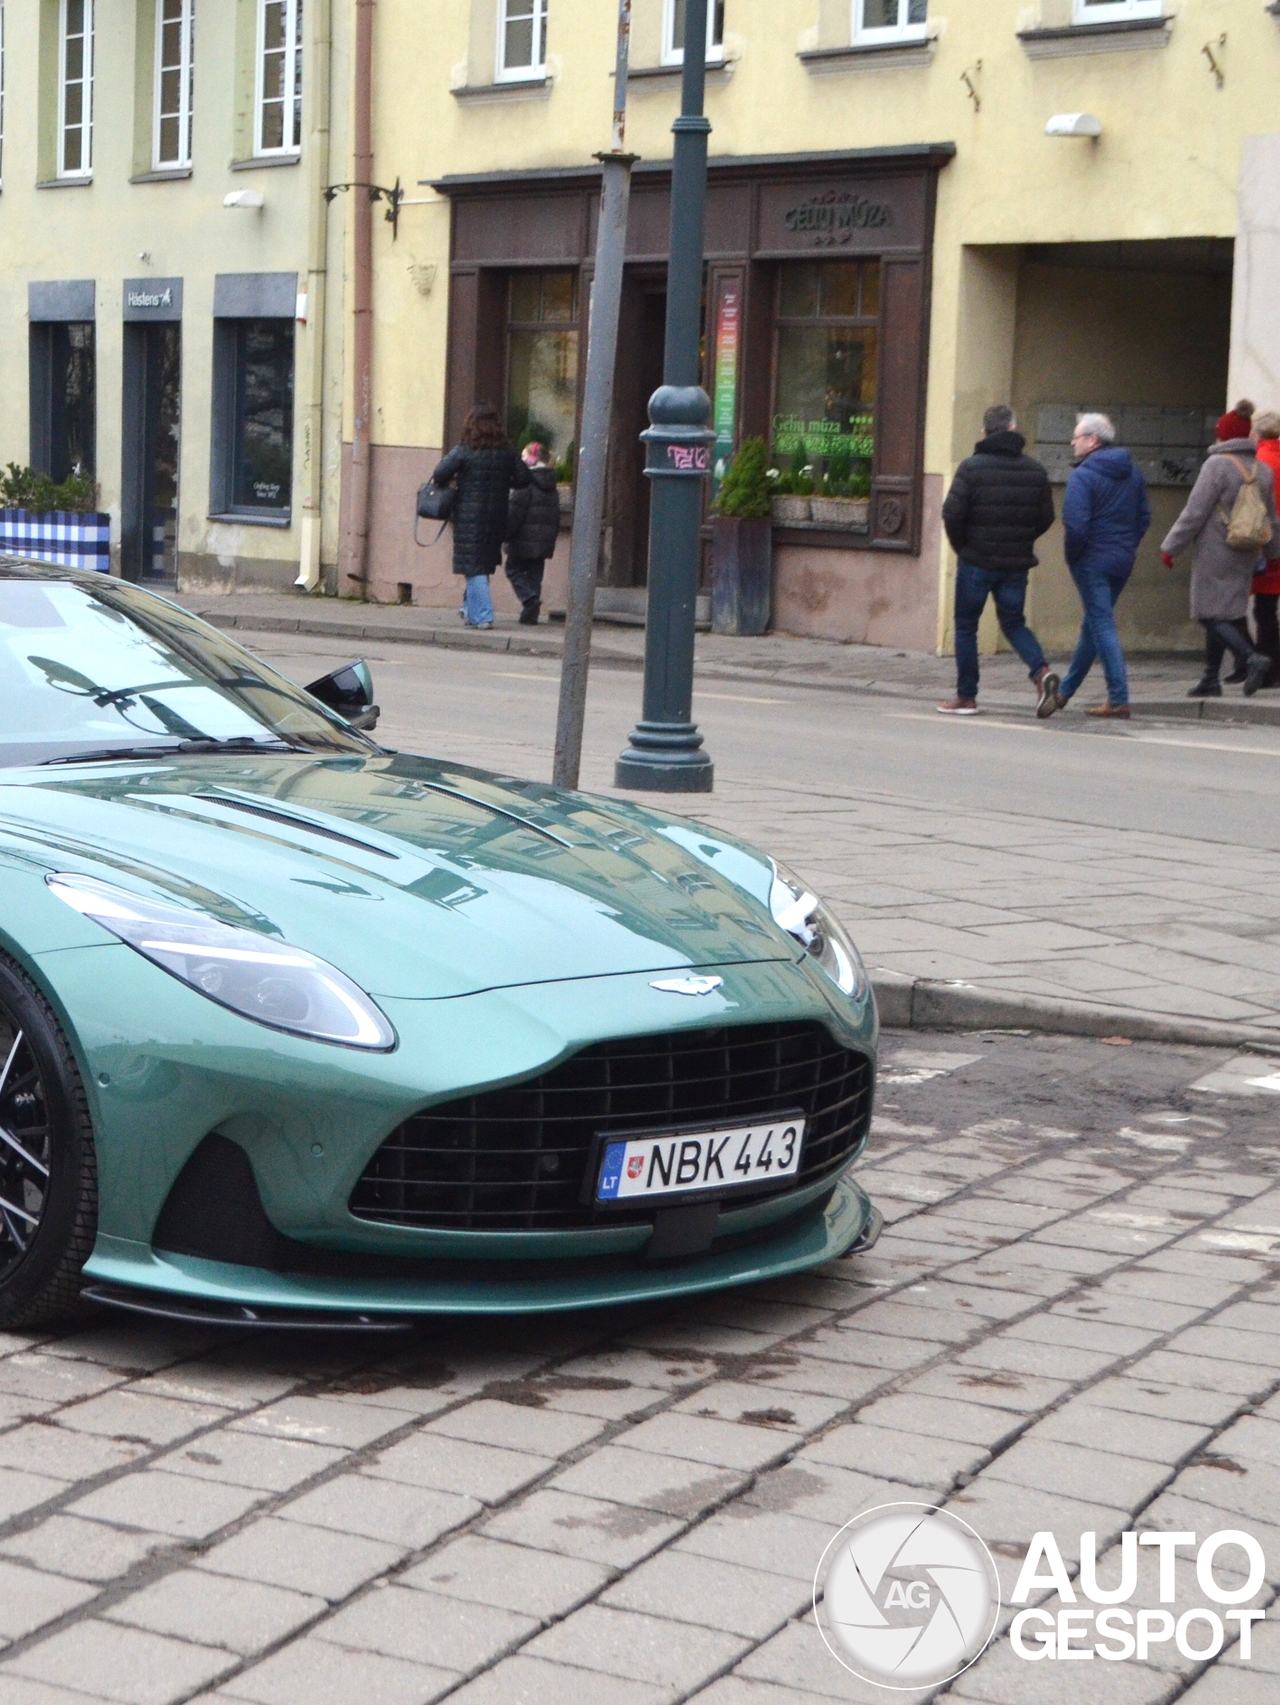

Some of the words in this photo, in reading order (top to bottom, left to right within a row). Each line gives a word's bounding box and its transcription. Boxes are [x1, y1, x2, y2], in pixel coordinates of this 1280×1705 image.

[646, 1135, 732, 1188] NBK
[734, 1126, 797, 1176] 443
[602, 1175, 619, 1190] LT
